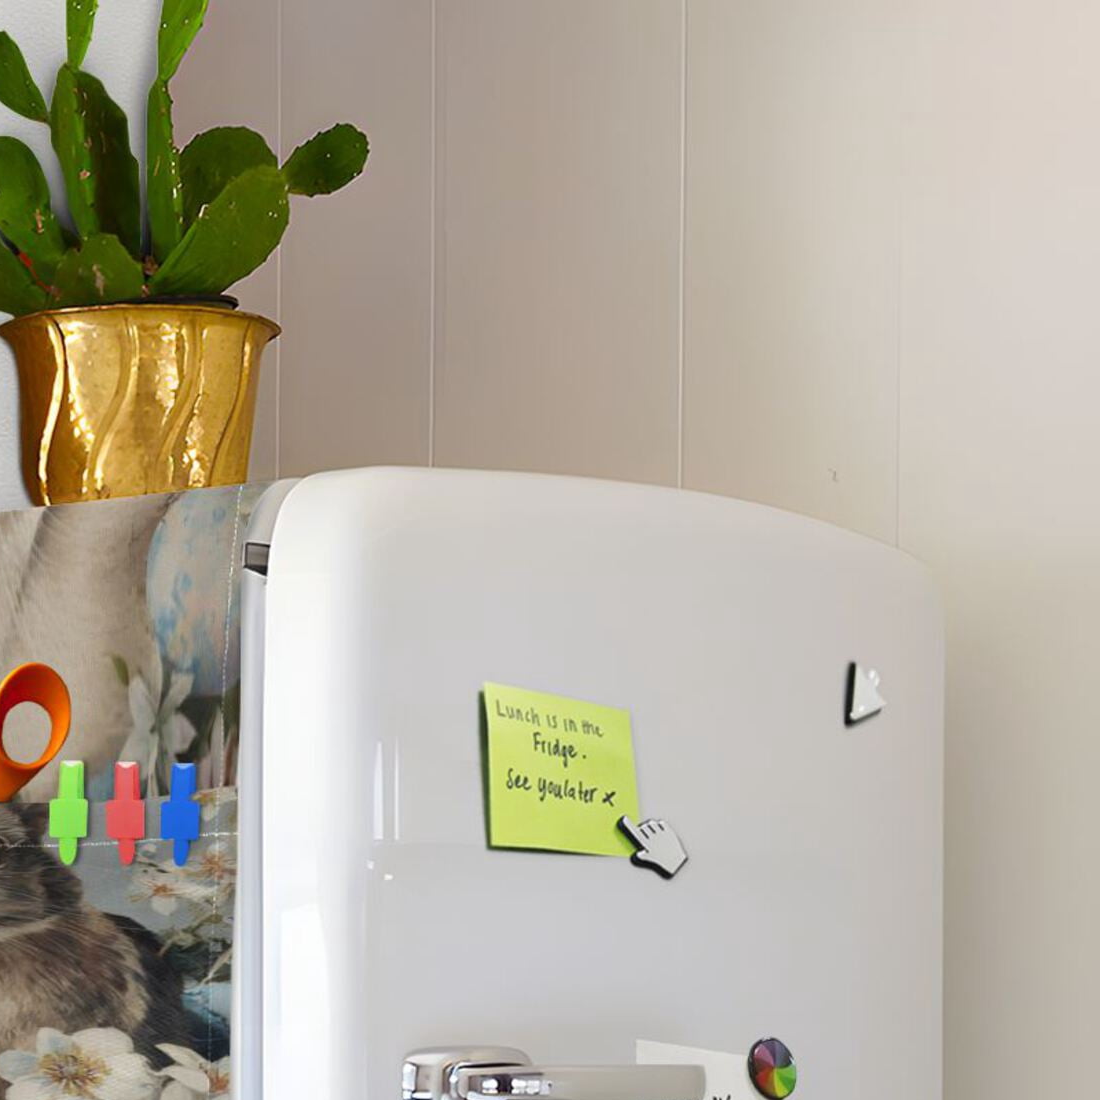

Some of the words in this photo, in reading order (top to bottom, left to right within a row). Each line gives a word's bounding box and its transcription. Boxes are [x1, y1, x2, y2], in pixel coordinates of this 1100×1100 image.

[495, 699, 541, 728] Lunch
[563, 718, 579, 733] in
[581, 719, 604, 738] the
[506, 767, 532, 790] See
